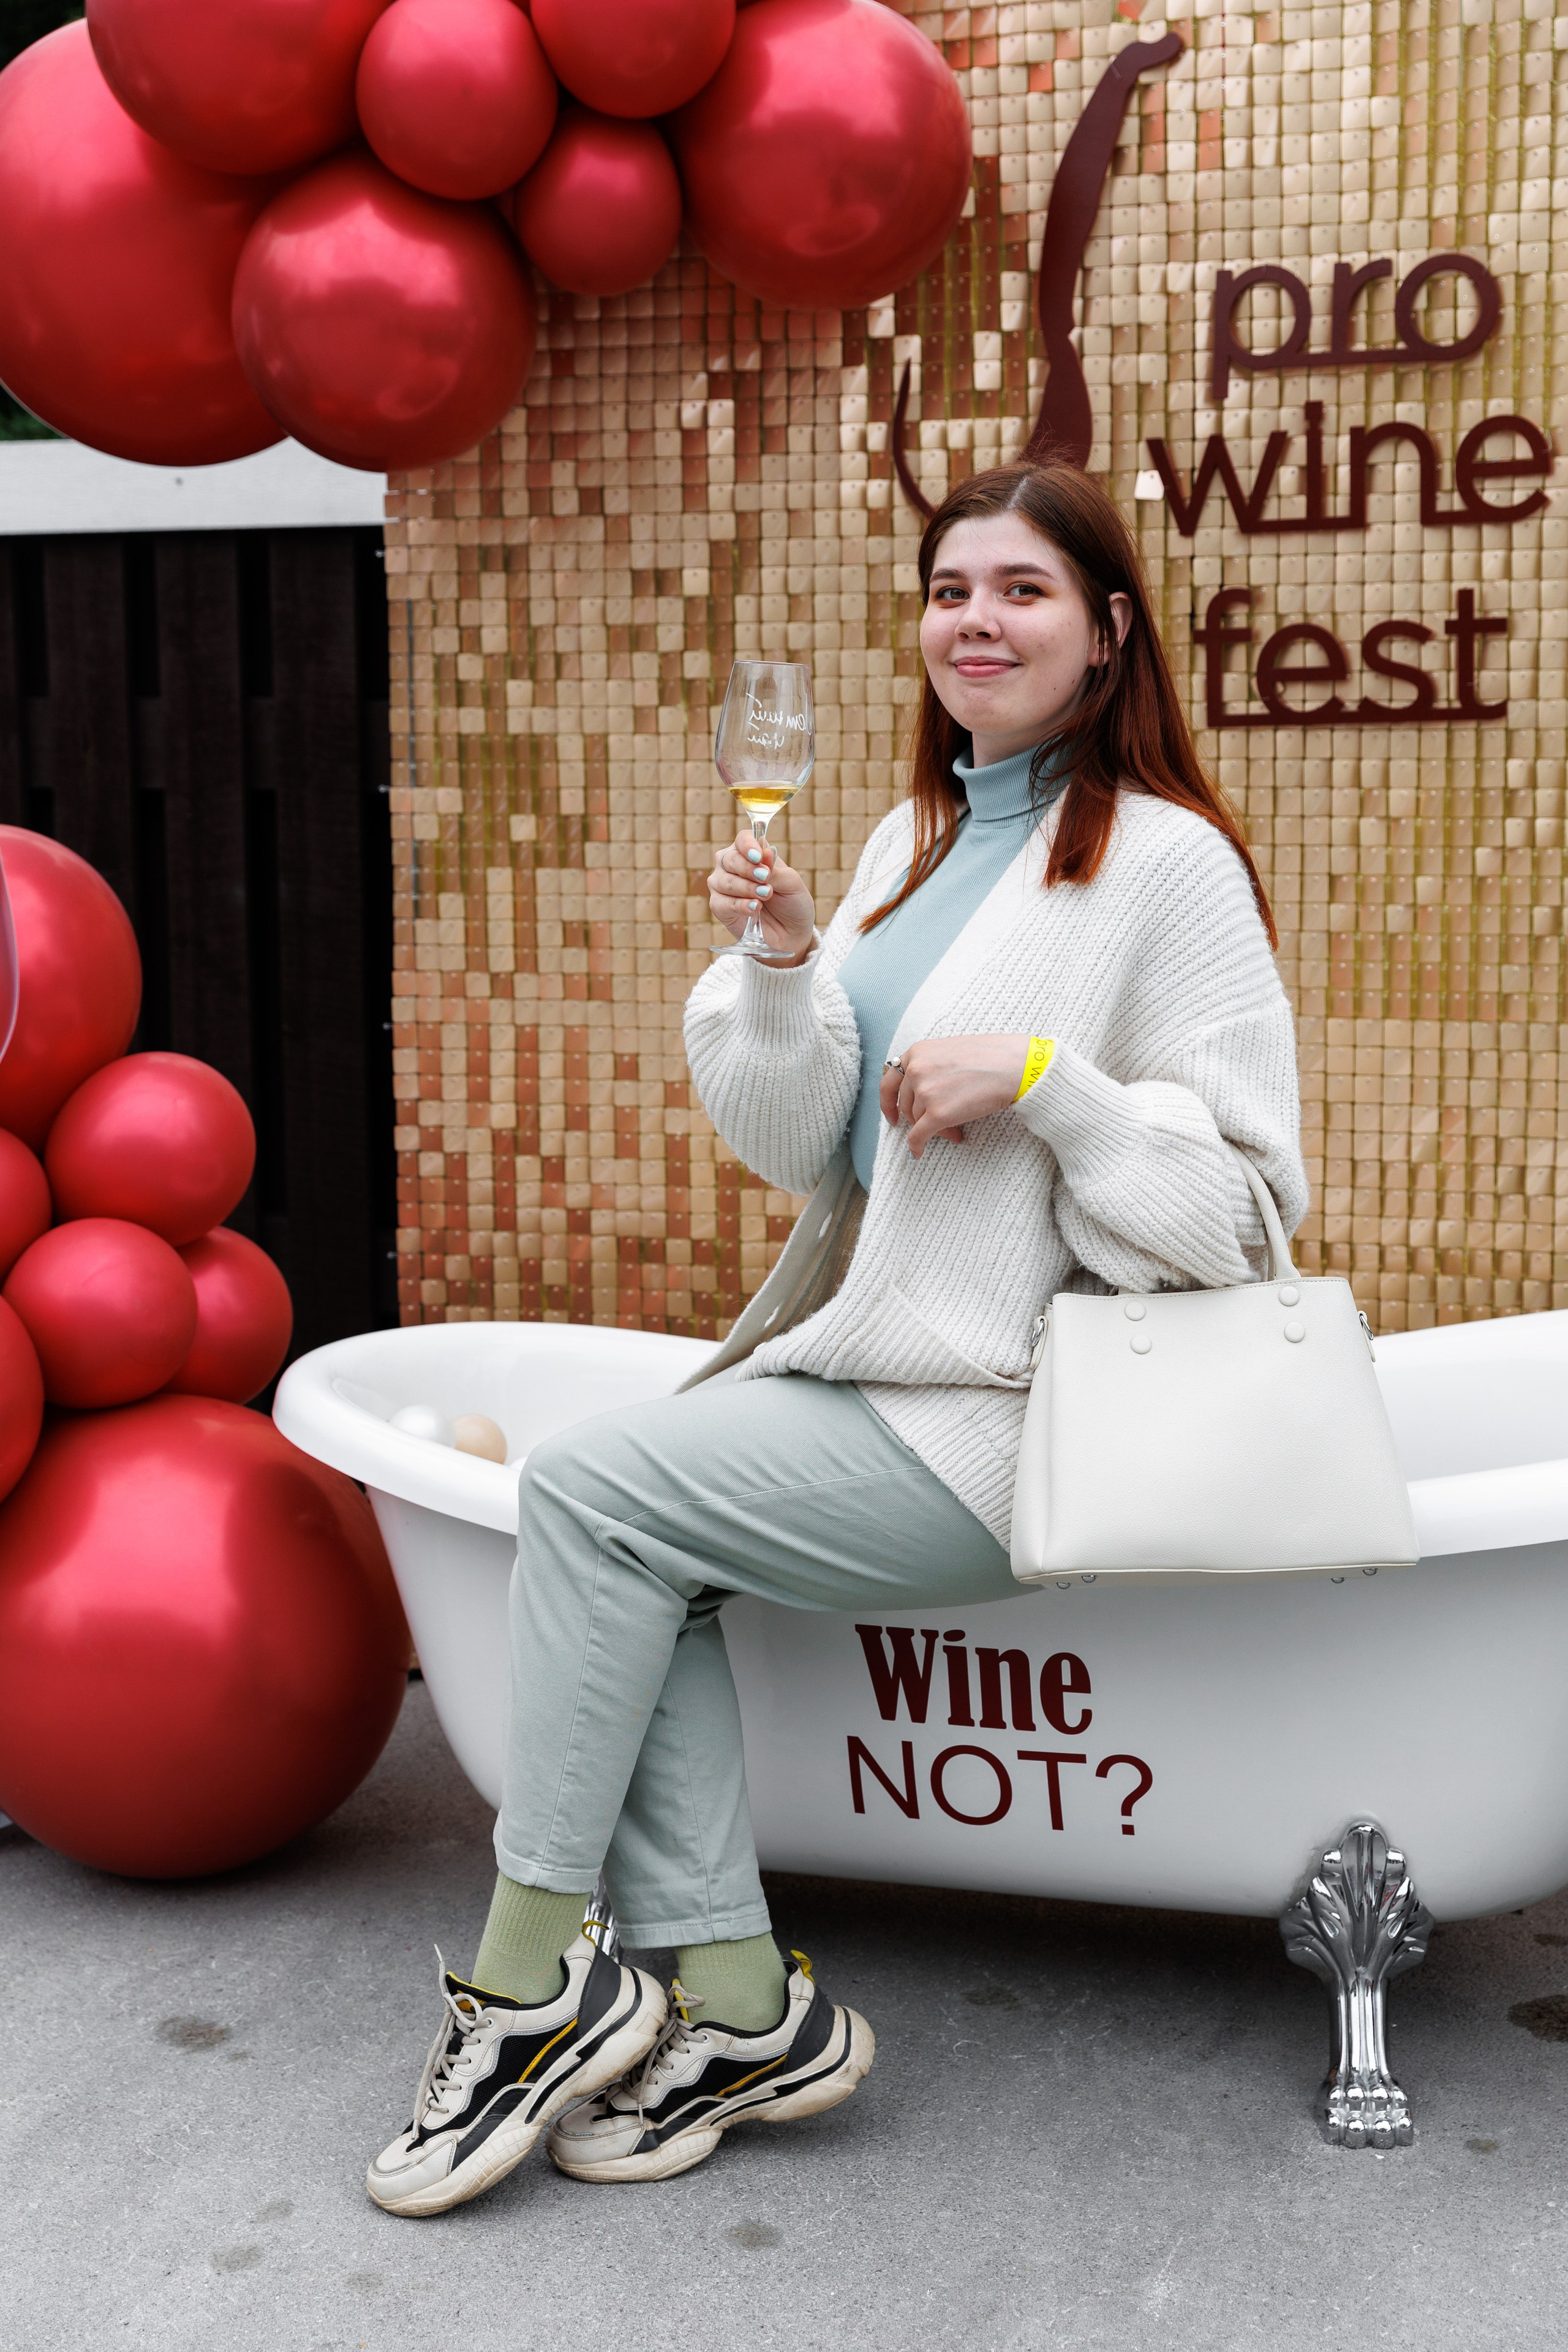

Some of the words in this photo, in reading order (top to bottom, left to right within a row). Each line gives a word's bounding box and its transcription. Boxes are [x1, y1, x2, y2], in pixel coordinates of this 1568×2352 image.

[1212, 253, 1503, 399] pro
[1147, 401, 1553, 537] wine
[1193, 587, 1508, 727] fest
[854, 1624, 1092, 1735] Wine
[847, 1736, 1153, 1836] NOT?
